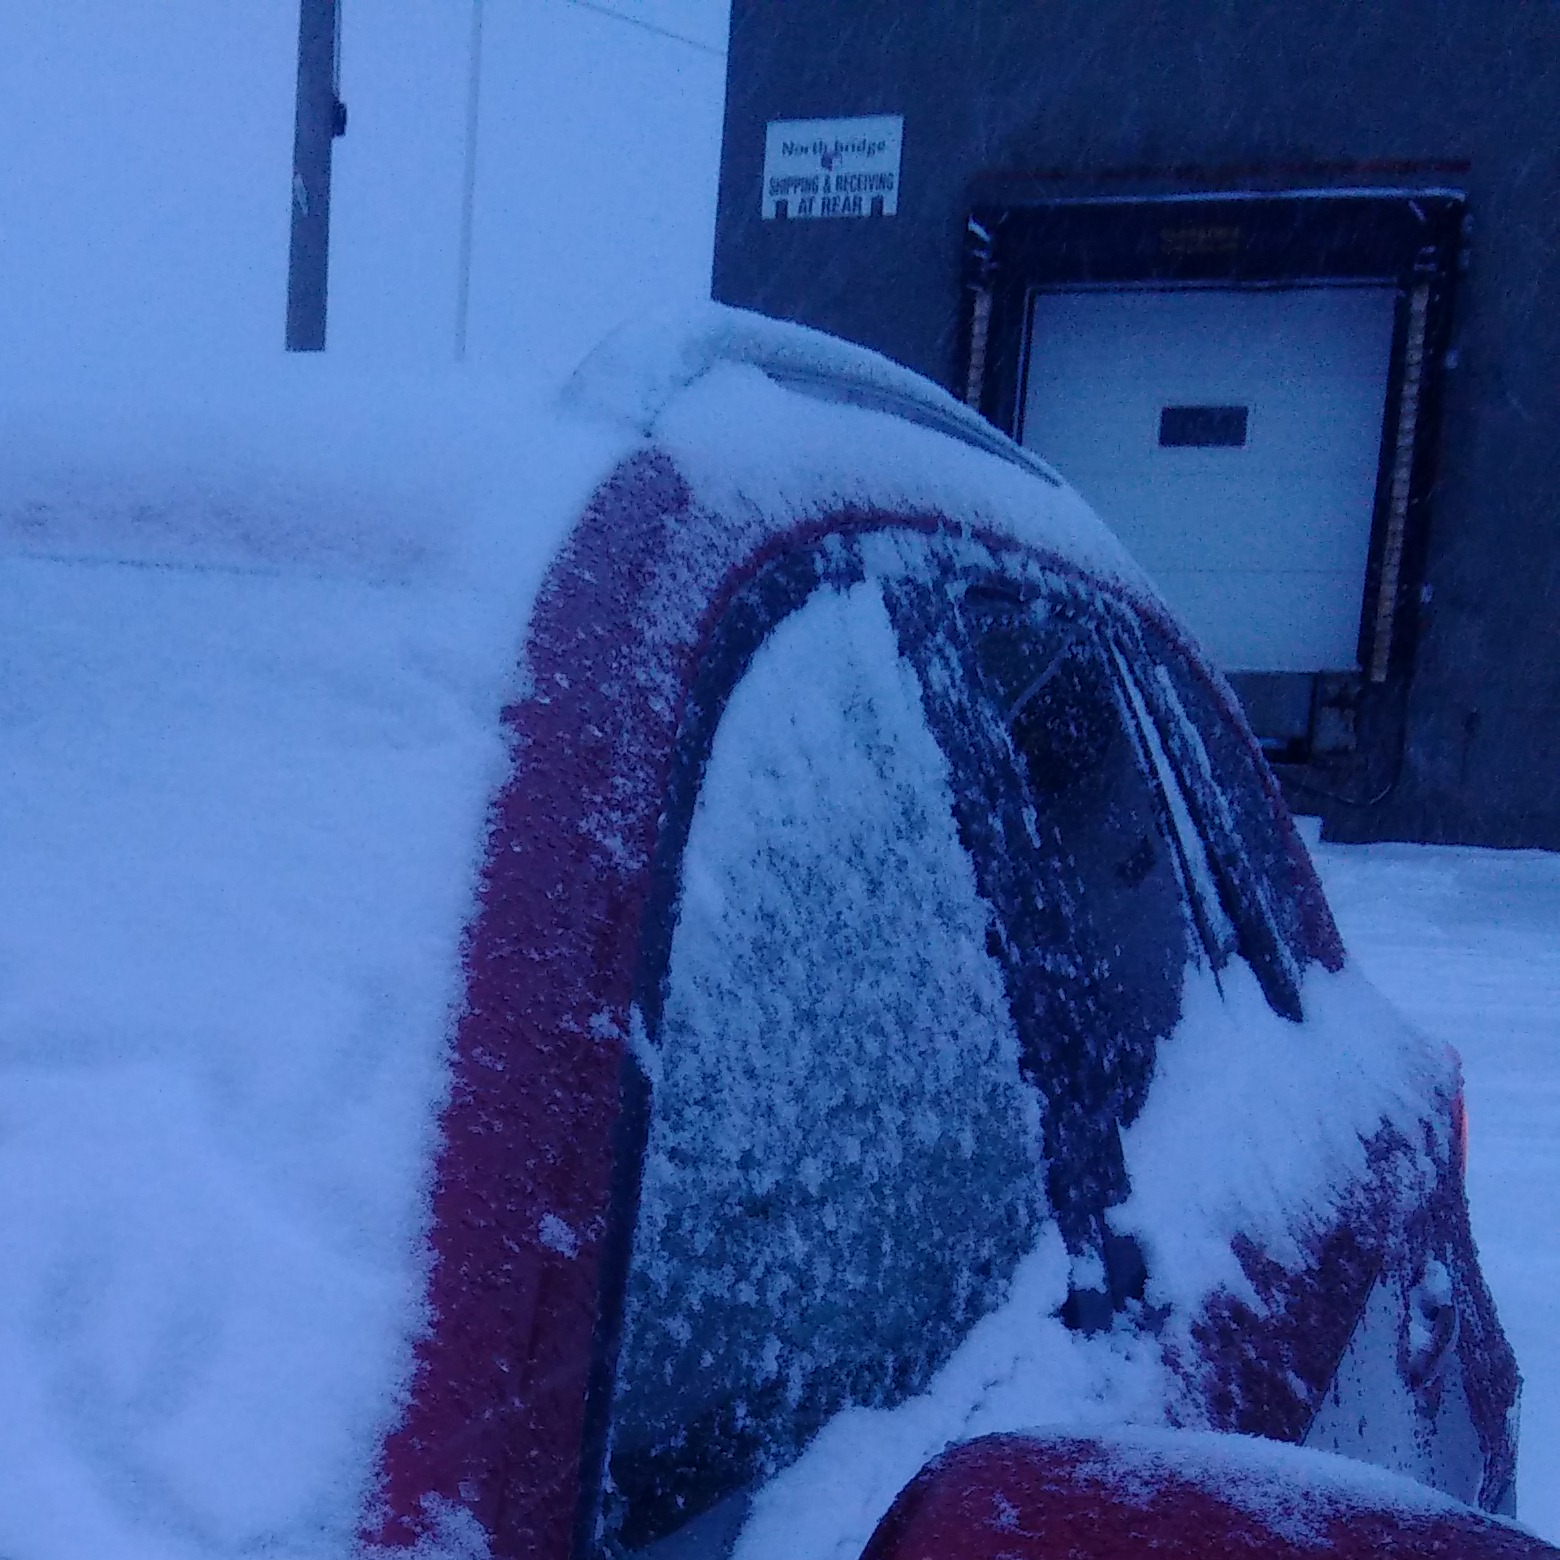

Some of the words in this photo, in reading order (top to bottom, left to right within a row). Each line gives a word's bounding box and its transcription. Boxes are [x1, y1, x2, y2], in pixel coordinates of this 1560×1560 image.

[769, 174, 819, 196] SHIPPING
[823, 174, 831, 194] &
[835, 172, 894, 193] RECEIVING
[798, 197, 815, 214] AT
[821, 196, 863, 215] REAR
